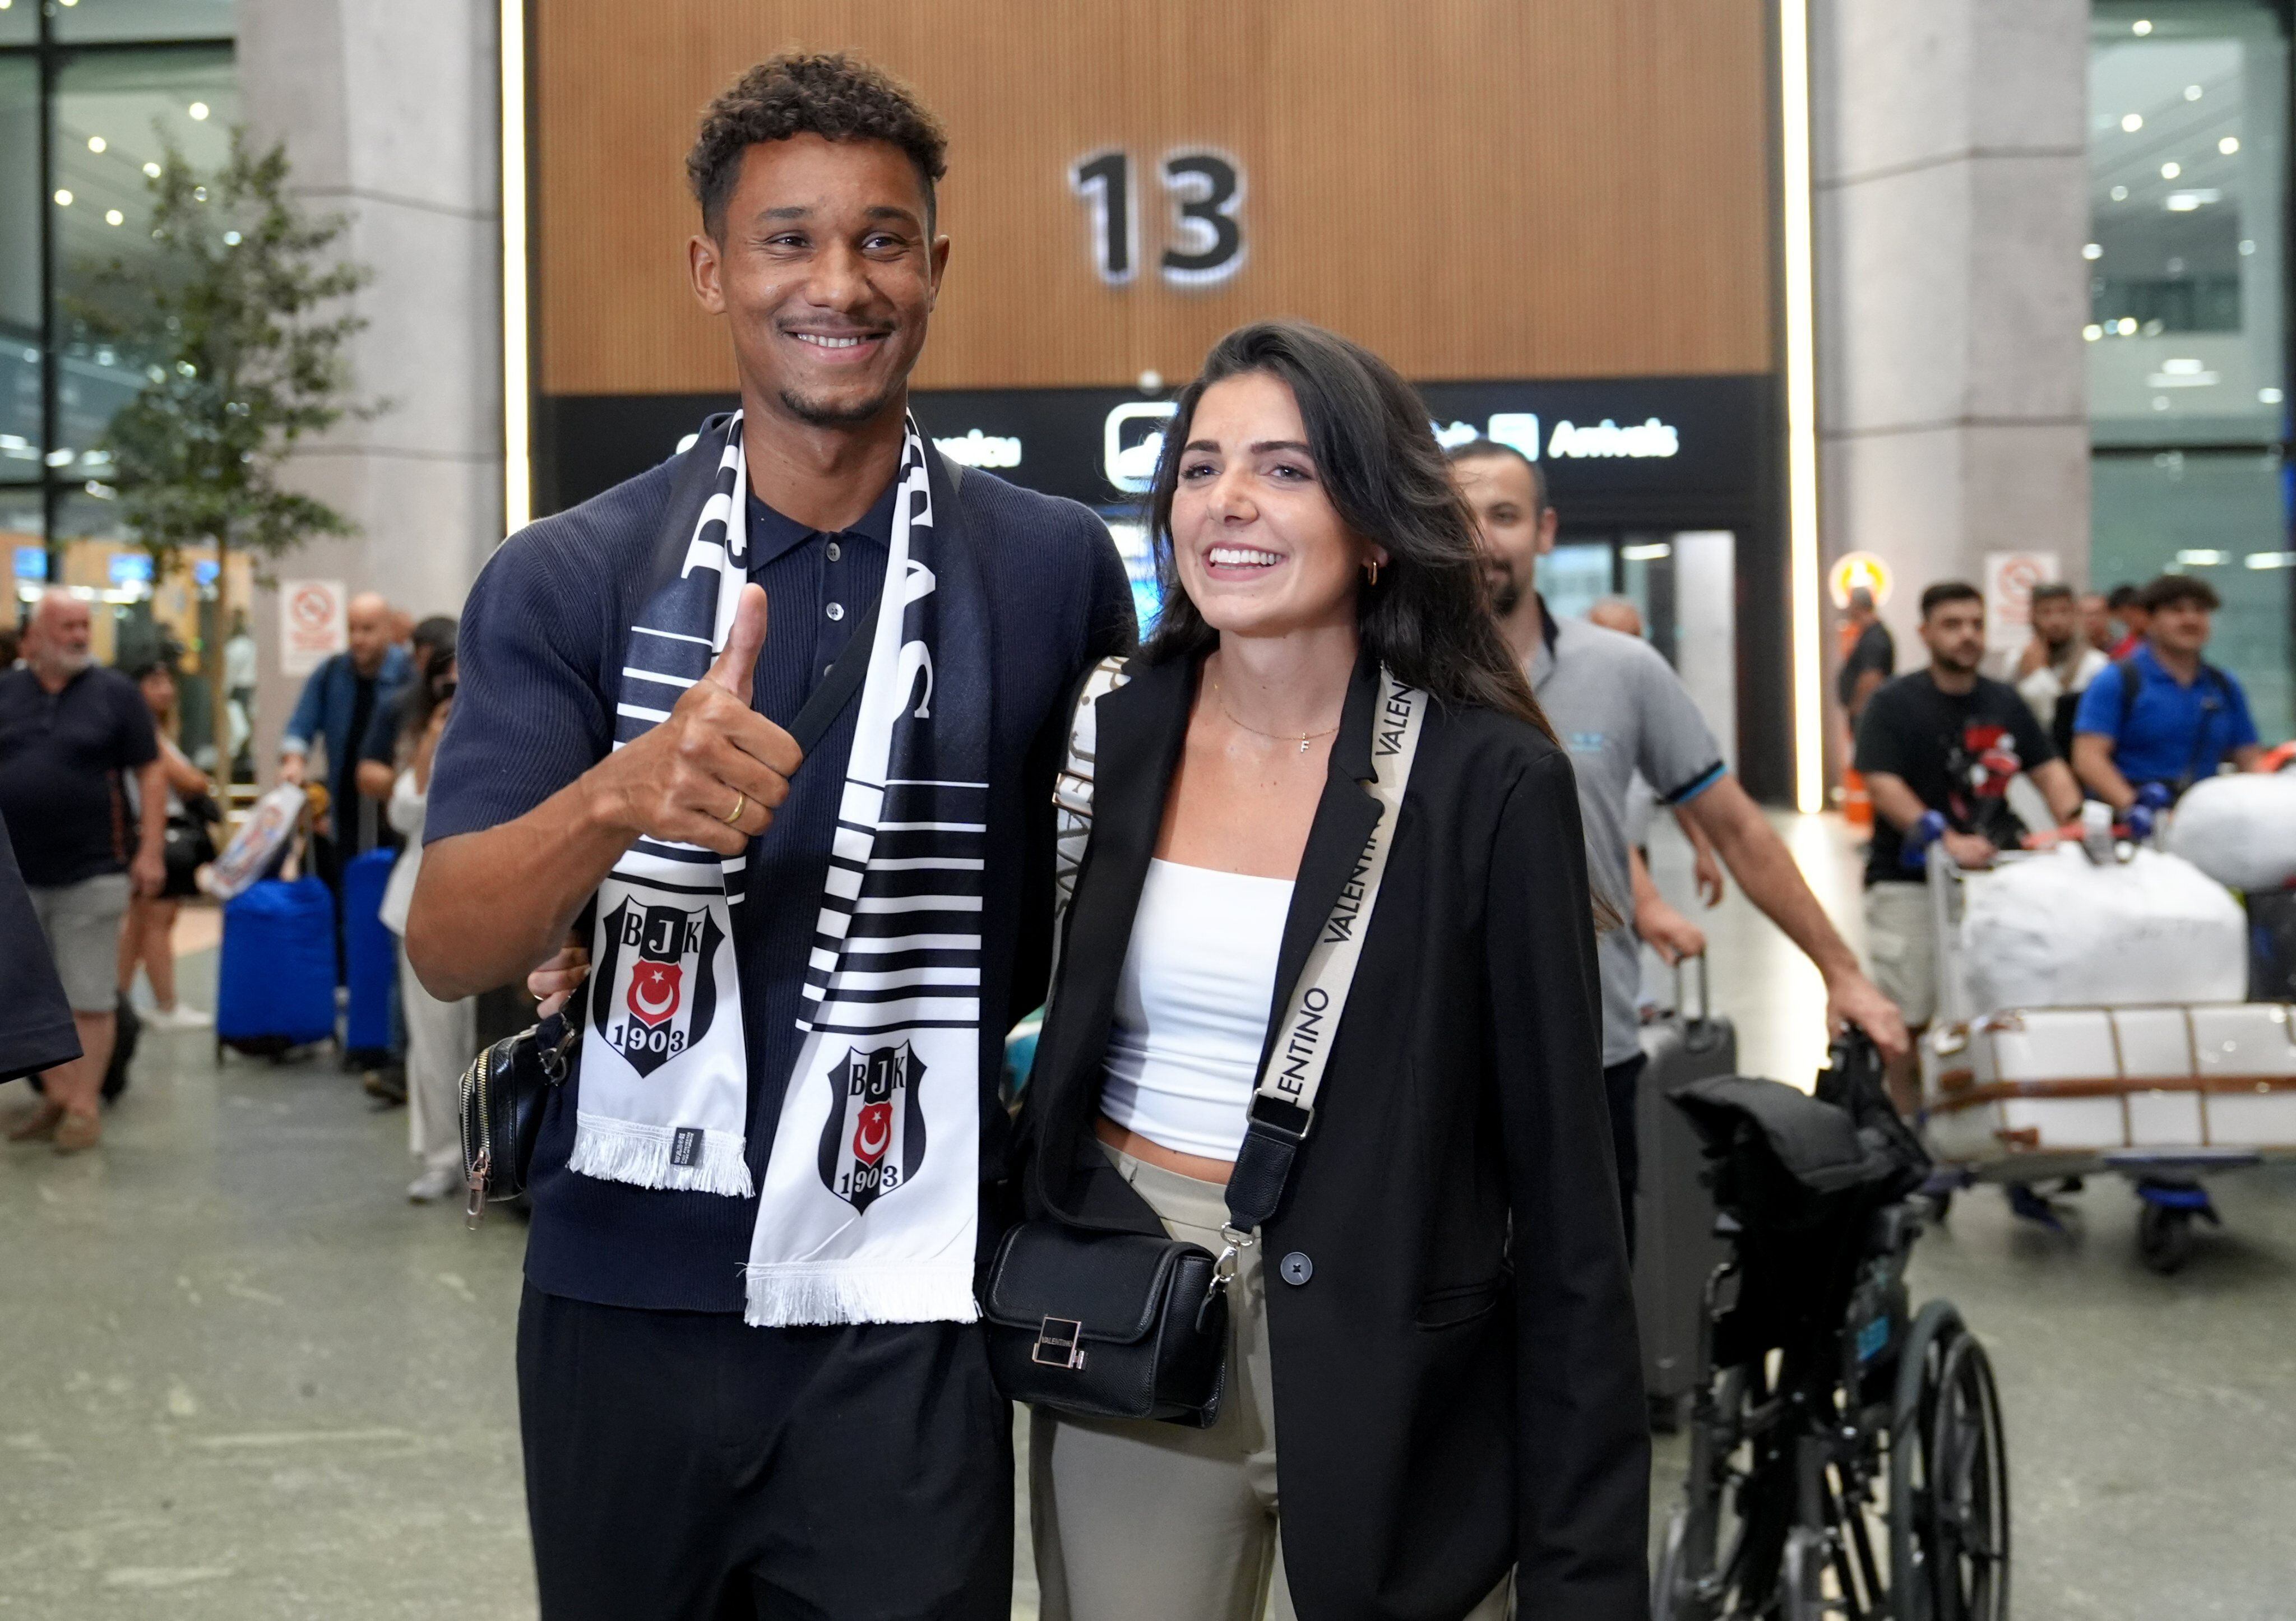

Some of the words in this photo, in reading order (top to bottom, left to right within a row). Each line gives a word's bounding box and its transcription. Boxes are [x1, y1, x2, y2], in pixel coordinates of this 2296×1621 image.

[1077, 152, 1240, 272] 13
[1375, 682, 1412, 757] VALEN
[1300, 740, 1310, 753] F
[621, 911, 702, 955] BJK
[613, 1023, 685, 1053] 1903
[1276, 987, 1330, 1107] LENTINO
[850, 1055, 906, 1096] BJK
[841, 1165, 899, 1195] 1903
